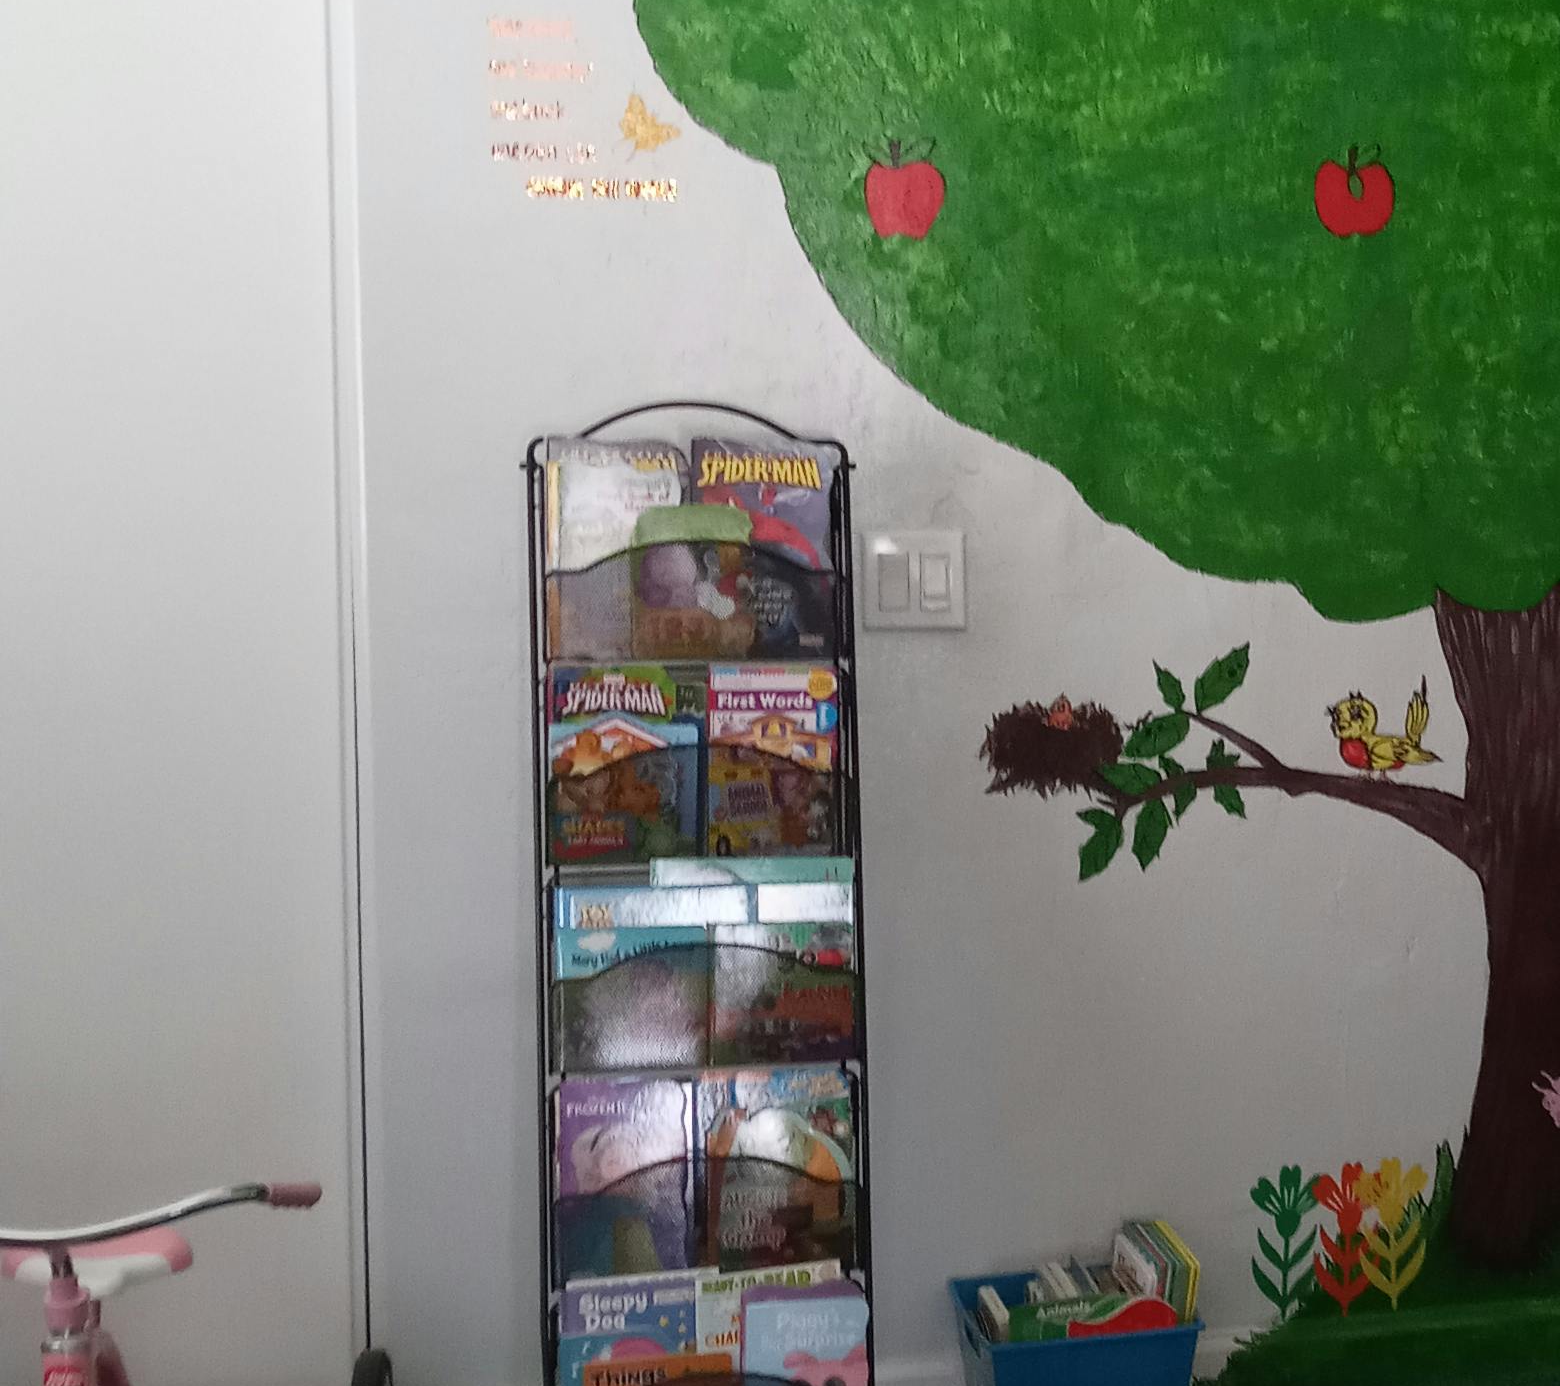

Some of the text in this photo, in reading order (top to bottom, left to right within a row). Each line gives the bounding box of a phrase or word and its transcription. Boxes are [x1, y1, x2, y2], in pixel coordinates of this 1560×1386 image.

[697, 455, 822, 491] SPIDER-MAN
[717, 691, 813, 709] First Words
